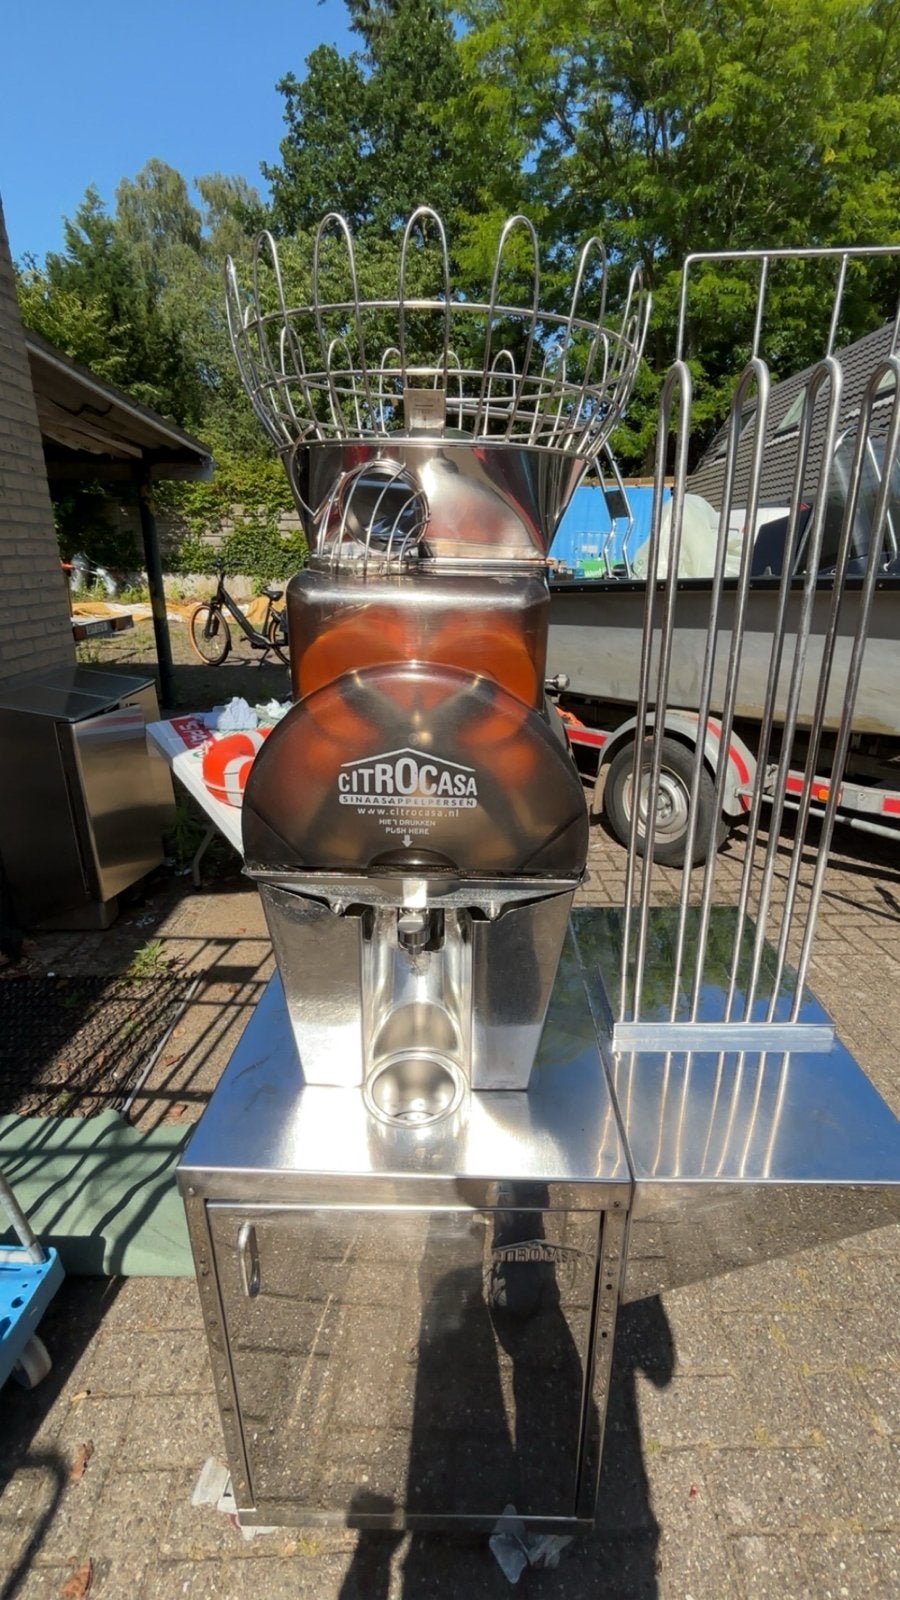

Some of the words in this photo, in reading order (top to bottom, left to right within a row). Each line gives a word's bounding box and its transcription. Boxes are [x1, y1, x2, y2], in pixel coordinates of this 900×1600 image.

[338, 757, 478, 796] CITROCASA
[342, 795, 475, 807] SINAASAPPELPERSEN
[357, 808, 459, 817] www.citrocasa.nl
[399, 819, 437, 827] DRUKKEN
